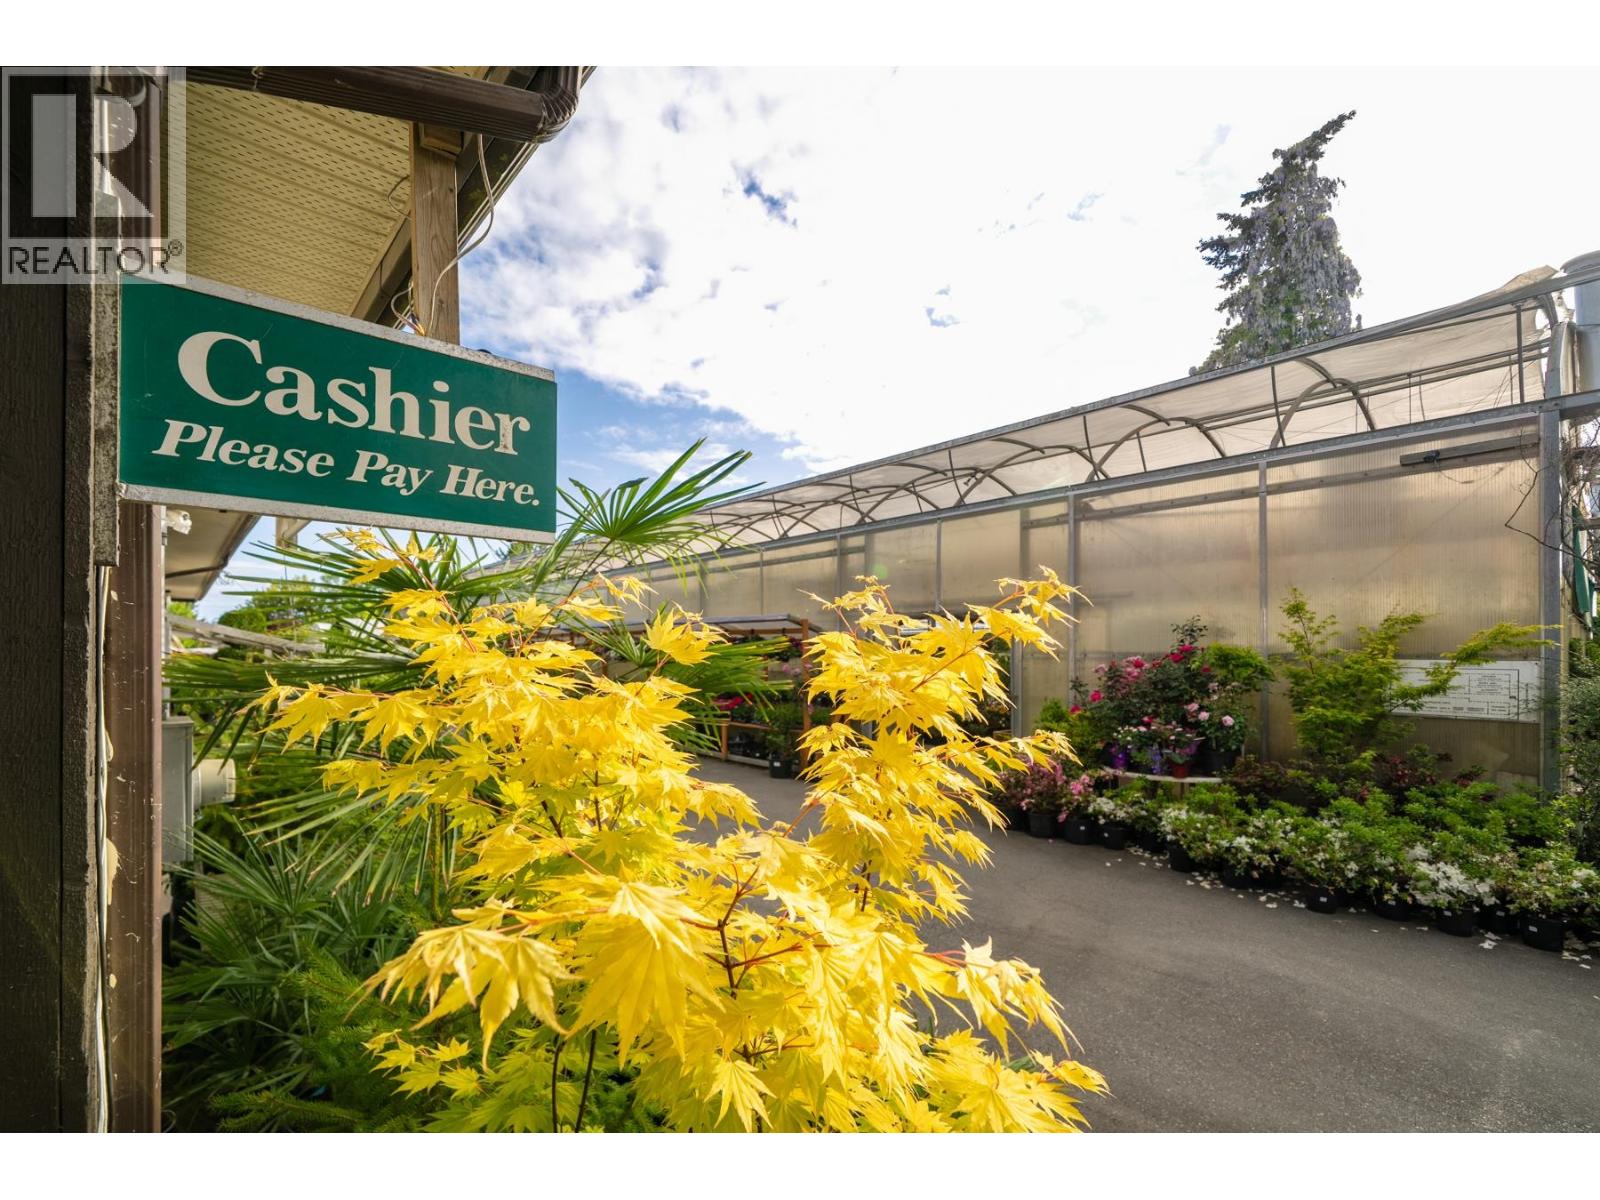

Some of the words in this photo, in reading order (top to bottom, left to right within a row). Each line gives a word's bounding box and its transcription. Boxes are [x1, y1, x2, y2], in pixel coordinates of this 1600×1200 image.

[178, 331, 531, 456] Cashier
[152, 419, 335, 477] Please
[346, 450, 434, 496] Pay
[439, 464, 541, 507] Here.
